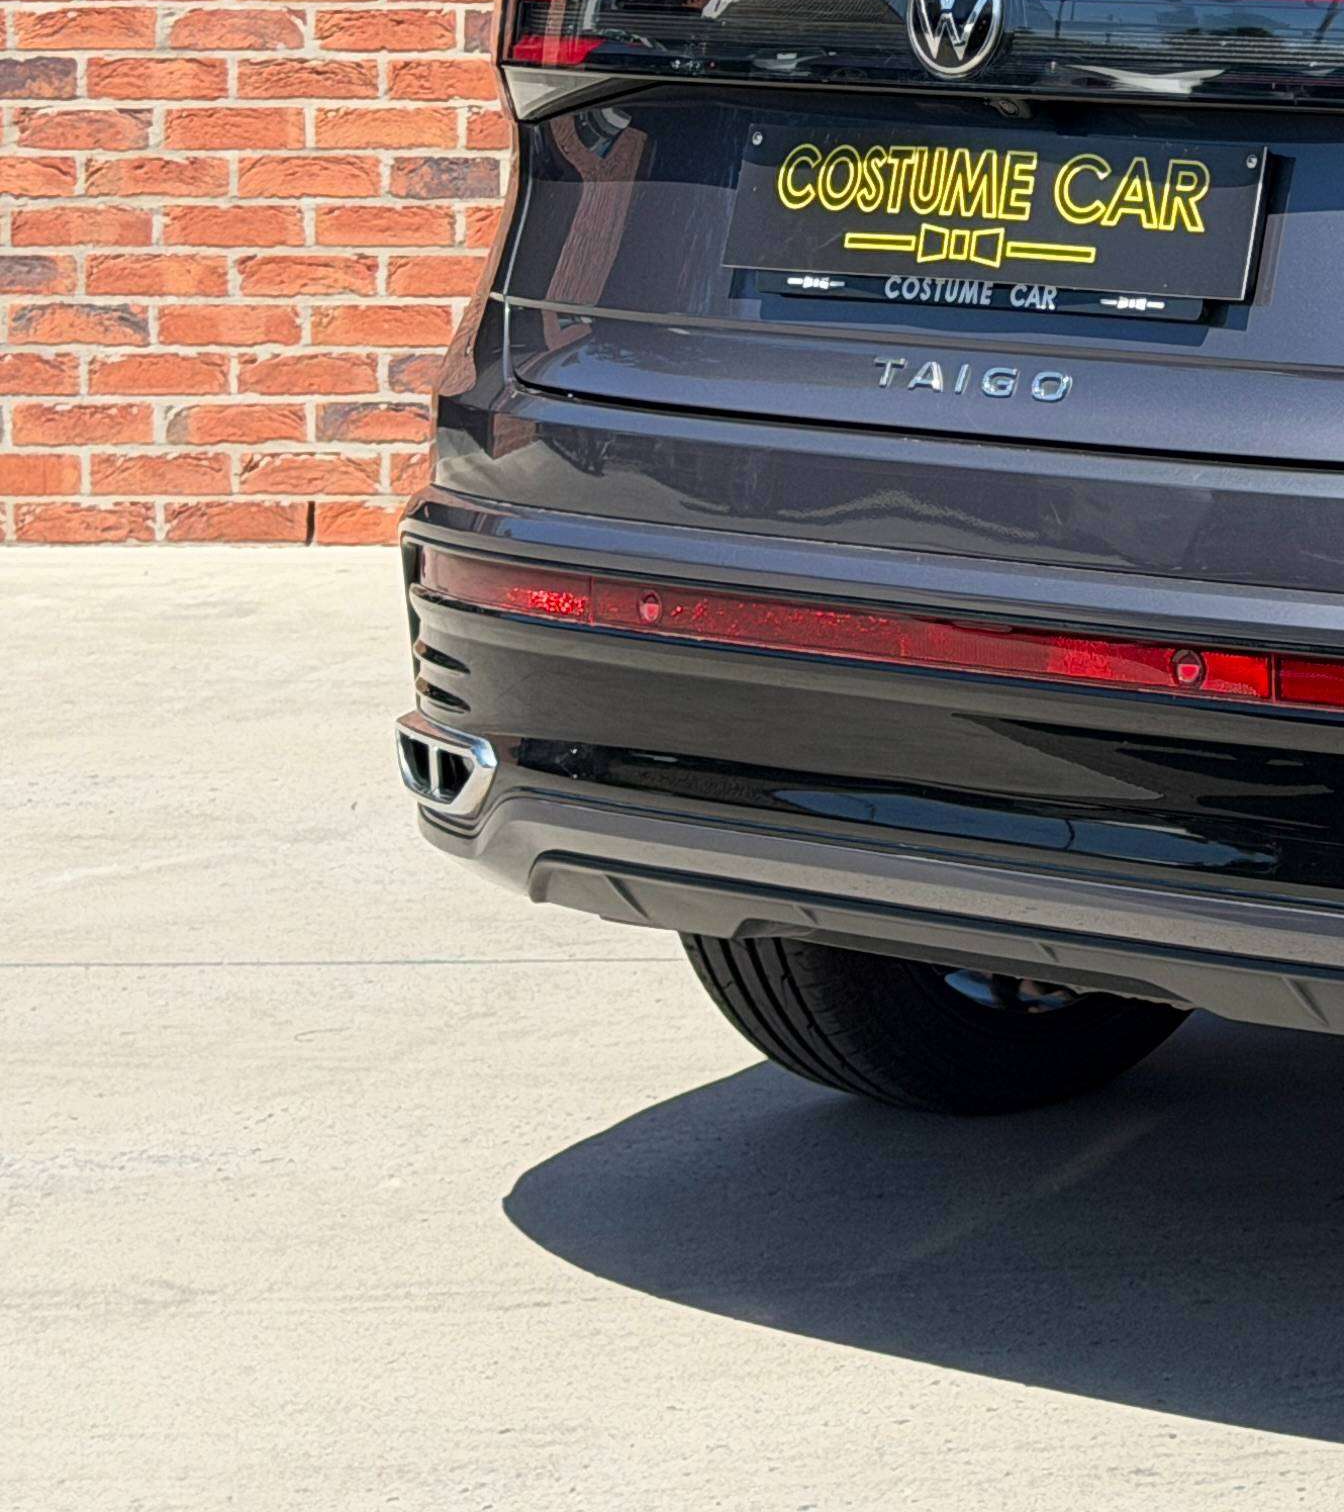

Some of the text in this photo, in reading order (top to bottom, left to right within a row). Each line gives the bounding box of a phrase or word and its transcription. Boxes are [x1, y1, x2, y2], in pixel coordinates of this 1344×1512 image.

[777, 143, 1211, 232] COSTUME CAR
[884, 275, 1058, 311] COSTUME CAR
[872, 357, 1074, 402] TAIGO
